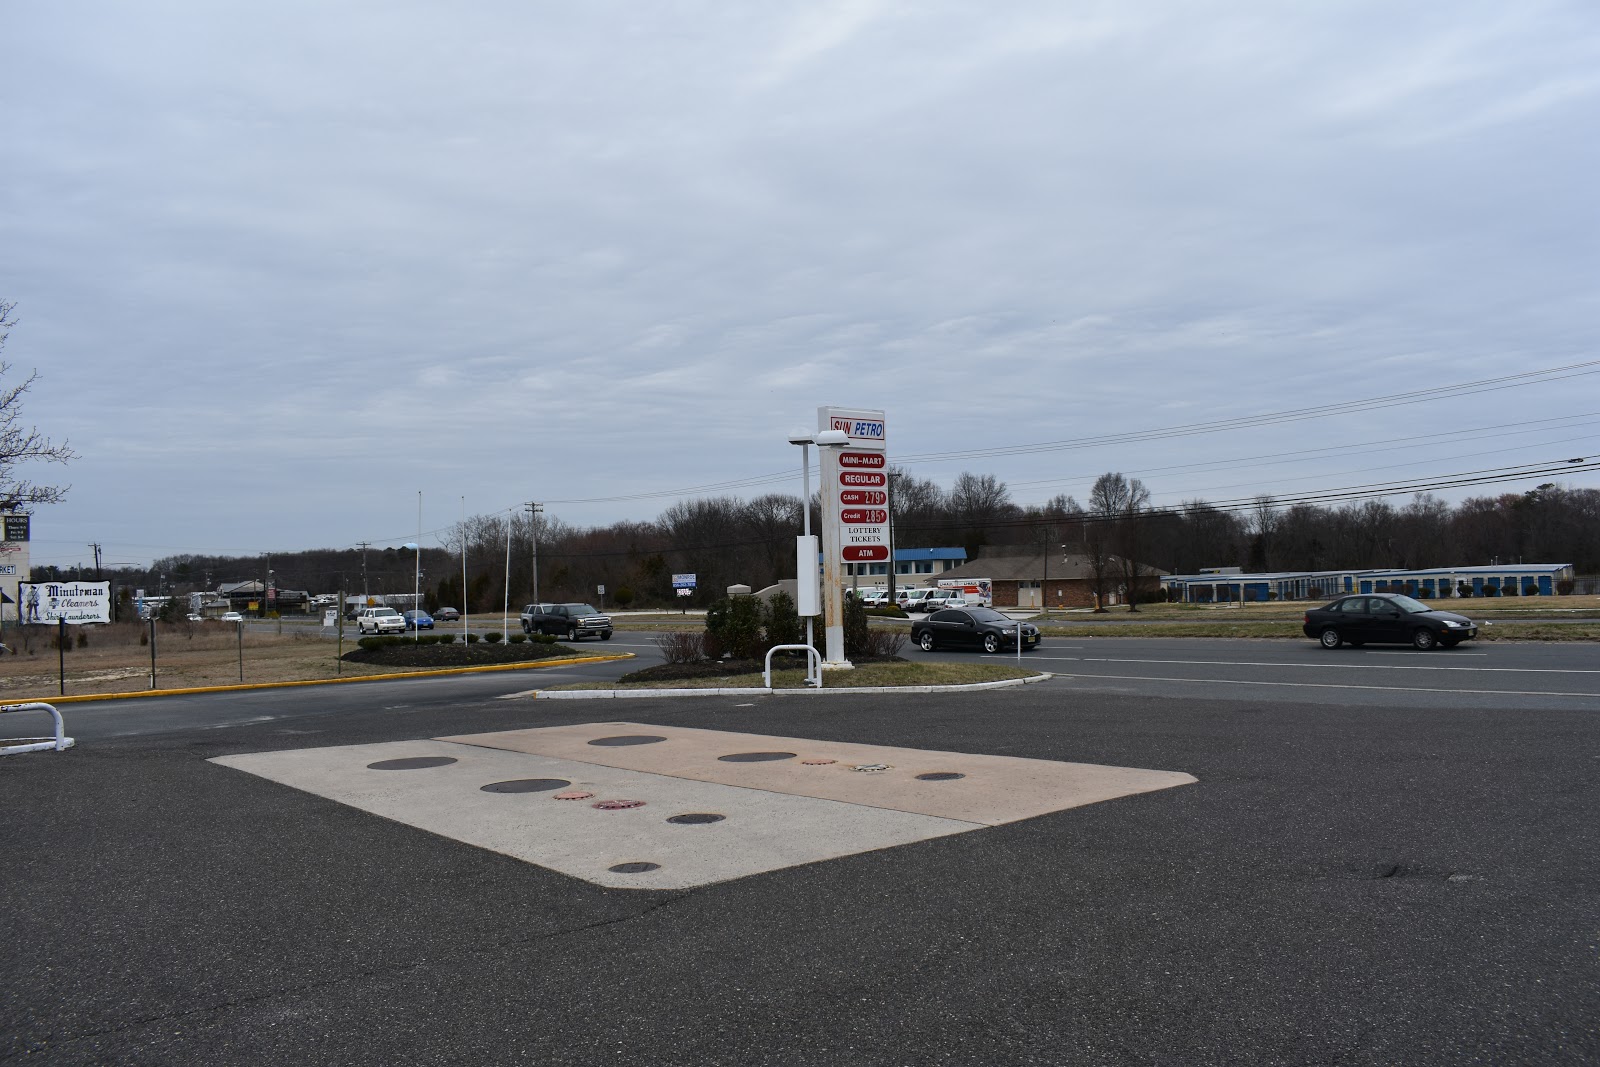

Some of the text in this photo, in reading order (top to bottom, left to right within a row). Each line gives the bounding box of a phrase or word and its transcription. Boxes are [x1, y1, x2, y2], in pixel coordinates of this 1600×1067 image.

[834, 420, 883, 437] SUN PETRO
[842, 456, 882, 465] MINI-MART
[845, 474, 881, 484] REGULAR
[858, 549, 874, 557] ATM
[45, 584, 103, 597] Minuteman
[61, 598, 99, 608] Cleaners
[45, 610, 102, 621] Shirt Launderers
